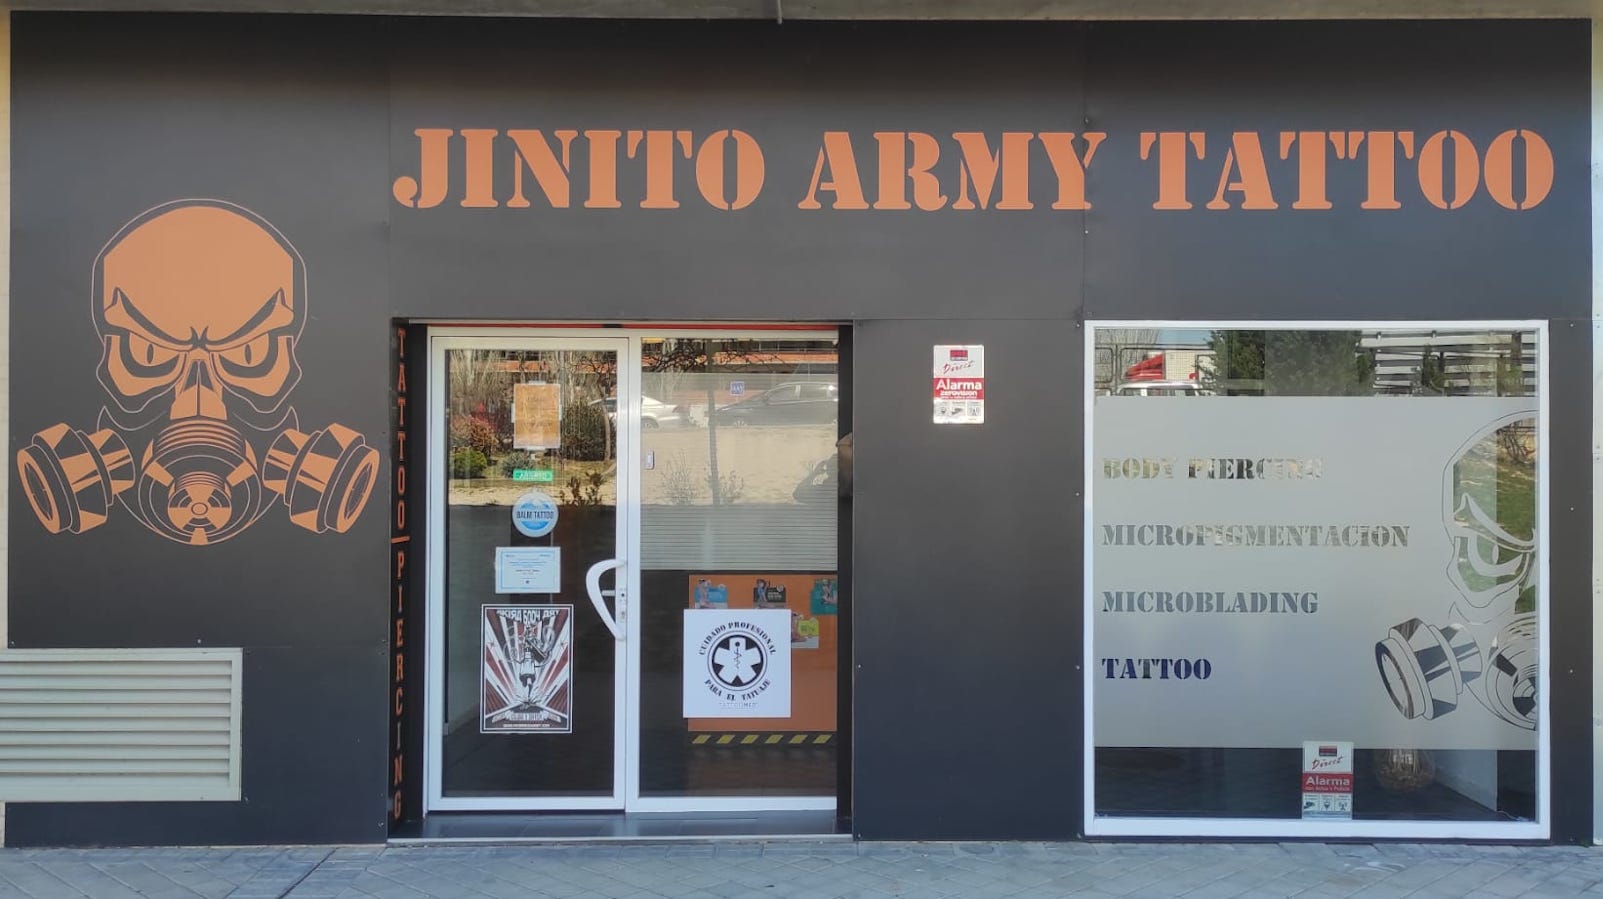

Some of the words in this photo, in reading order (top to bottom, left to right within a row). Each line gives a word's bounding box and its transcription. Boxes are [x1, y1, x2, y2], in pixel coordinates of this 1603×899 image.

[393, 128, 765, 211] JINITO
[798, 131, 1107, 212] ARMY
[1140, 129, 1555, 211] TATTOO
[936, 379, 982, 390] Alarma
[397, 328, 406, 530] TATTOO
[1103, 457, 1177, 480] BODY
[533, 511, 554, 519] TATTOO
[1102, 524, 1410, 548] MICROPIGMENTACION
[1102, 591, 1319, 613] MICROBLADING
[698, 625, 726, 655] CUIDADO
[728, 621, 776, 655] PROFESIONAL
[1102, 658, 1212, 680] TATTOO
[393, 551, 405, 820] PIERCING
[704, 679, 722, 696] PARA
[726, 693, 735, 701] EL
[741, 680, 771, 701] TATUAJE
[1312, 755, 1344, 770] Direct
[1306, 775, 1350, 786] Alarma
